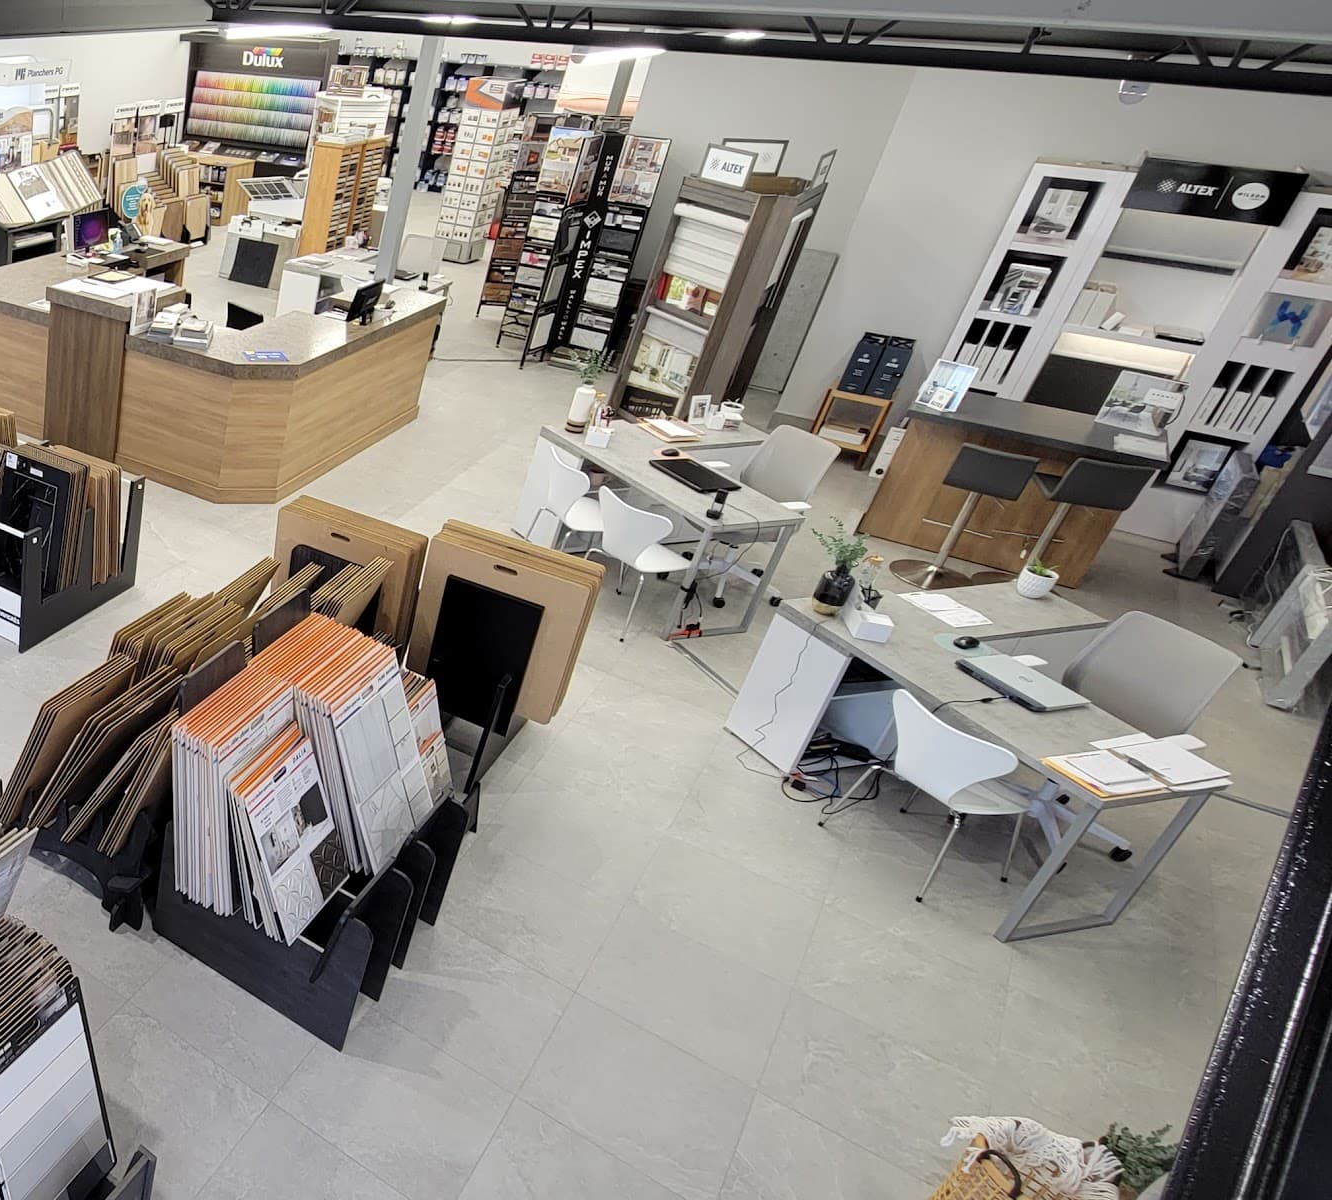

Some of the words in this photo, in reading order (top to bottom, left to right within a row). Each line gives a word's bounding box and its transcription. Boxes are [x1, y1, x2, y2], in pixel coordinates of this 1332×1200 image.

[242, 50, 284, 68] Dulux
[604, 155, 614, 172] MUR
[721, 161, 745, 175] ALTEX
[596, 180, 607, 197] MUR
[1176, 183, 1219, 197] ALTEX
